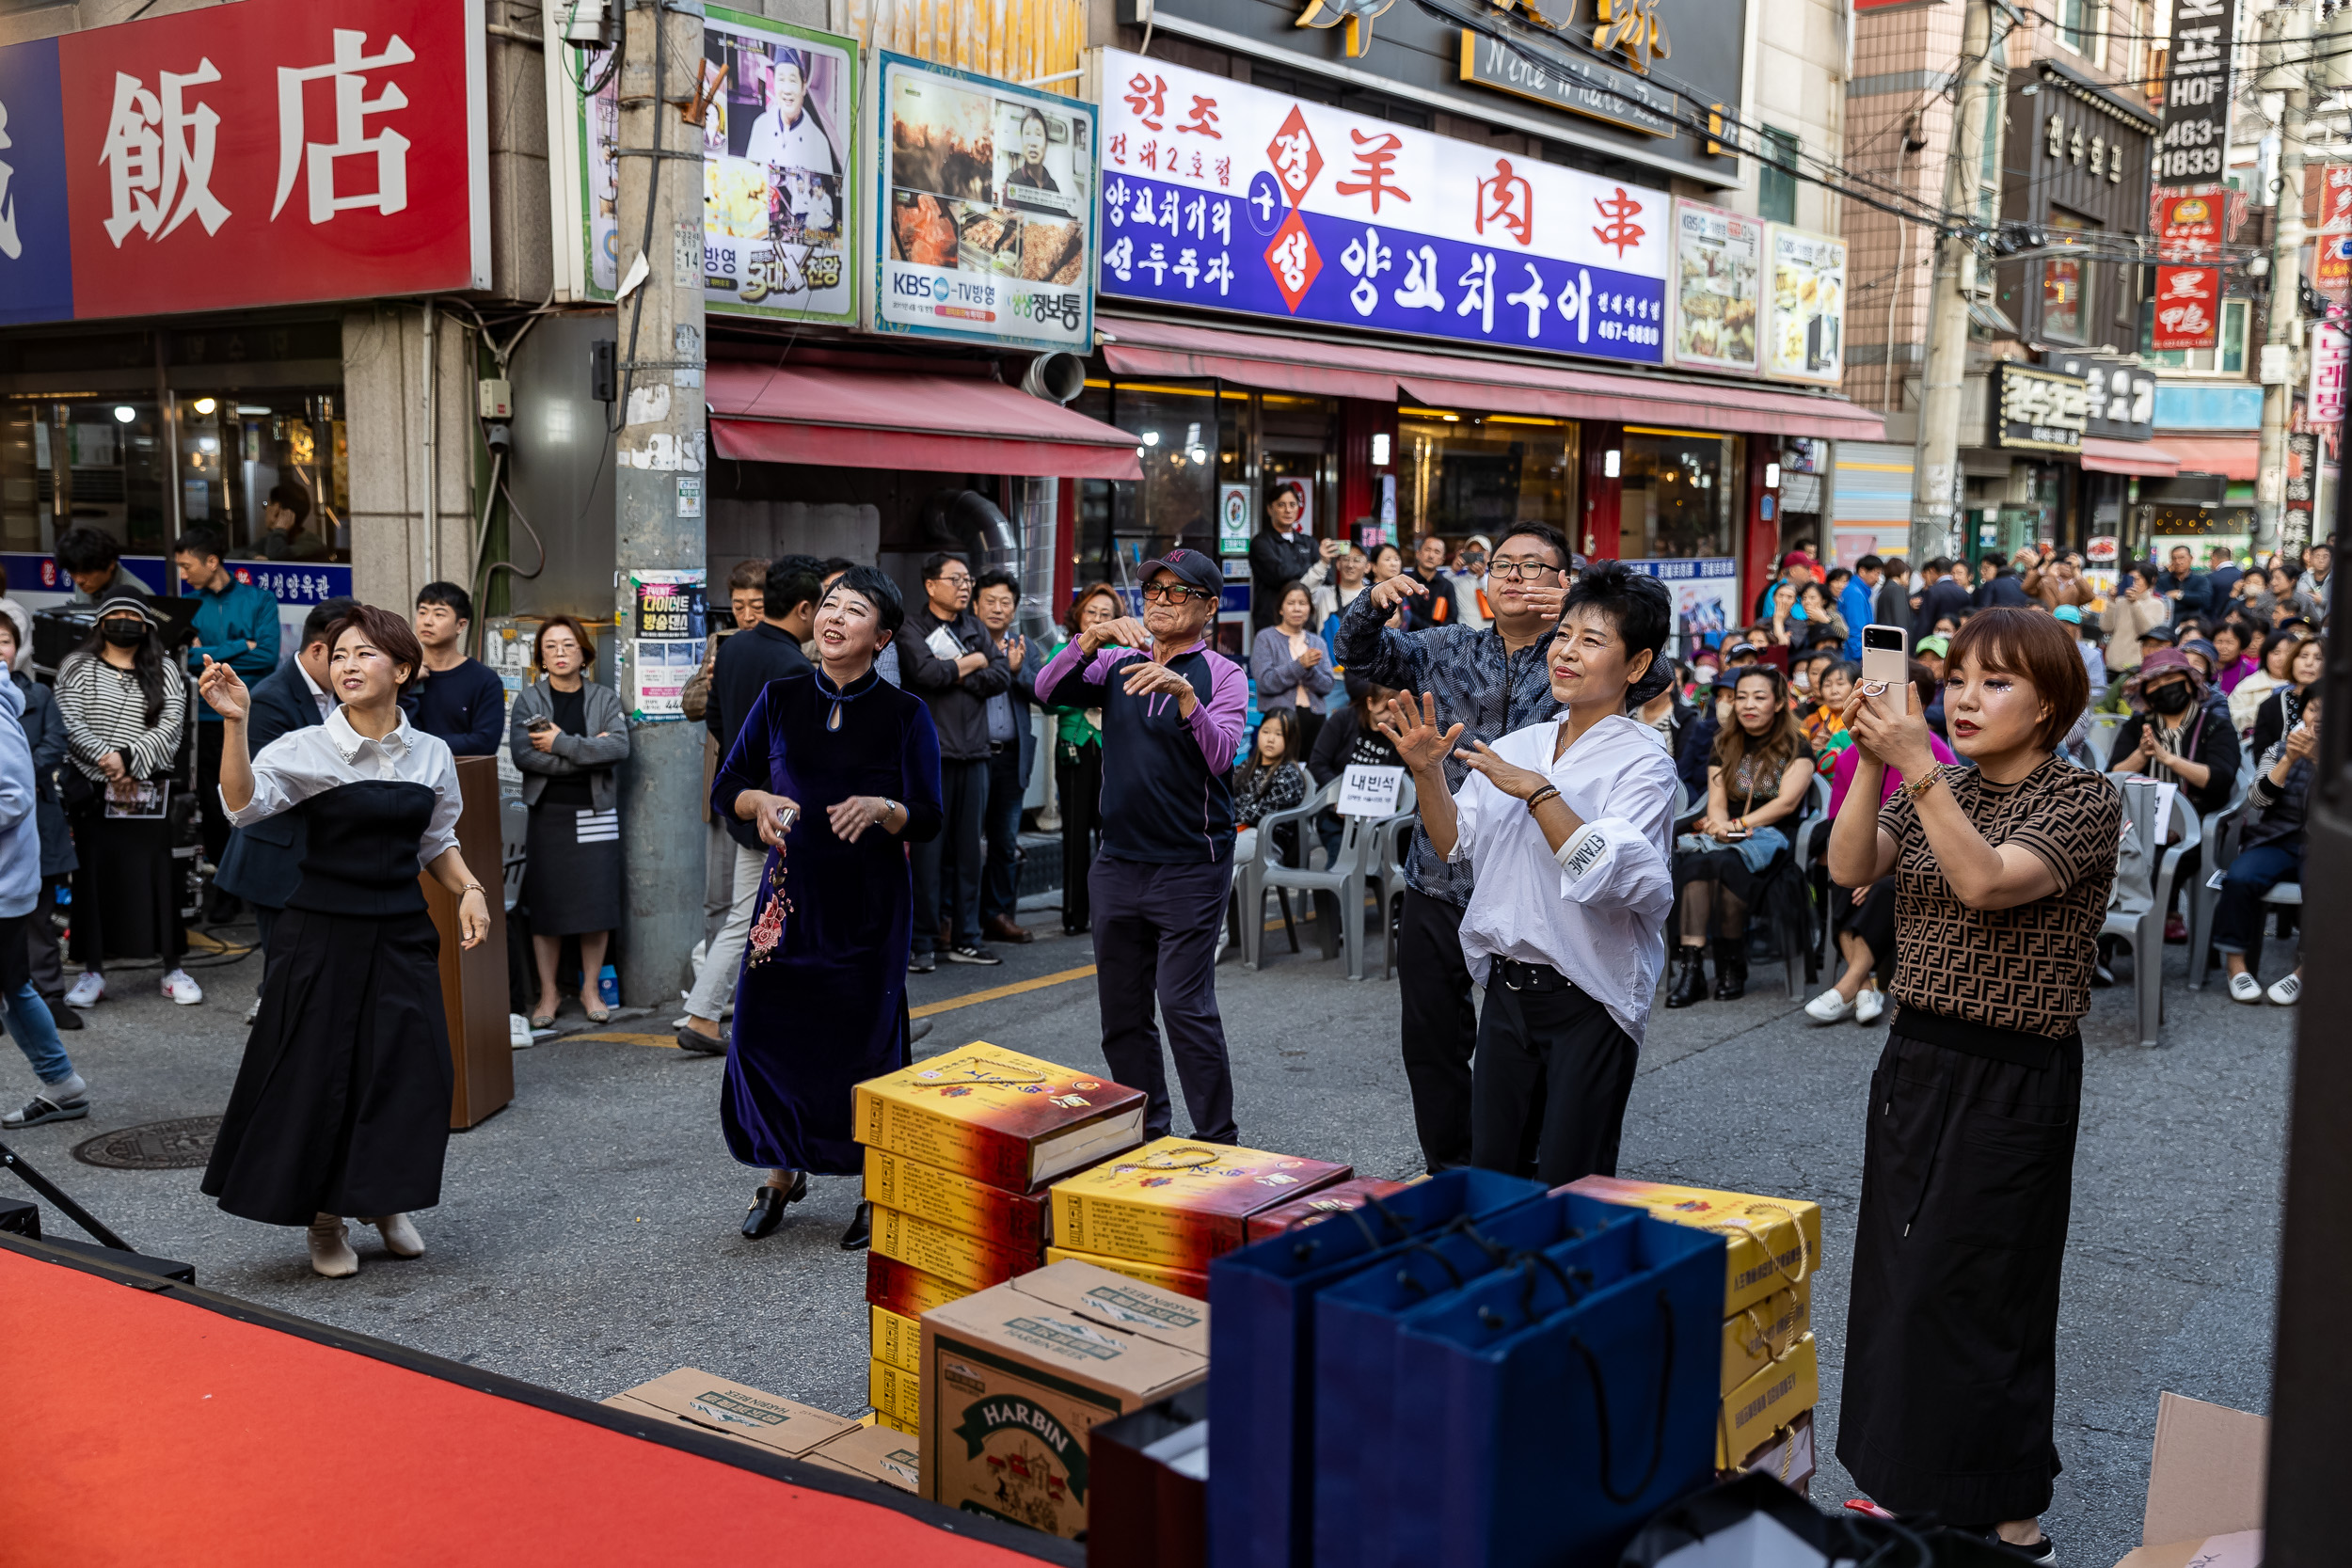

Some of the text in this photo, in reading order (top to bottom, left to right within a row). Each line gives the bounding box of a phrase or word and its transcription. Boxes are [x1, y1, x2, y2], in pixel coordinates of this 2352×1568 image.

[1486, 39, 1547, 91] Nine
[1123, 72, 1222, 139] 원조
[2170, 75, 2225, 107] HOF
[98, 28, 415, 248] 飯店
[2164, 119, 2224, 147] 463-
[2162, 147, 2220, 178] 1833
[1104, 178, 1232, 245] 양꼬치거리
[1251, 182, 1275, 221] 구
[1335, 128, 1645, 260] 羊肉串
[685, 251, 698, 269] 14
[704, 246, 736, 274] 방영
[1103, 235, 1234, 295] 선두주자
[893, 273, 930, 297] KBS
[1340, 227, 1592, 343] 양꼬치구이
[1012, 291, 1082, 332] 생생정보통
[643, 595, 689, 612] 다이어트
[643, 613, 688, 631] 방송댄스
[1351, 774, 1394, 792] 내빈석
[723, 1389, 790, 1415] HARBIN BEER
[982, 1402, 1069, 1453] HARBIN
